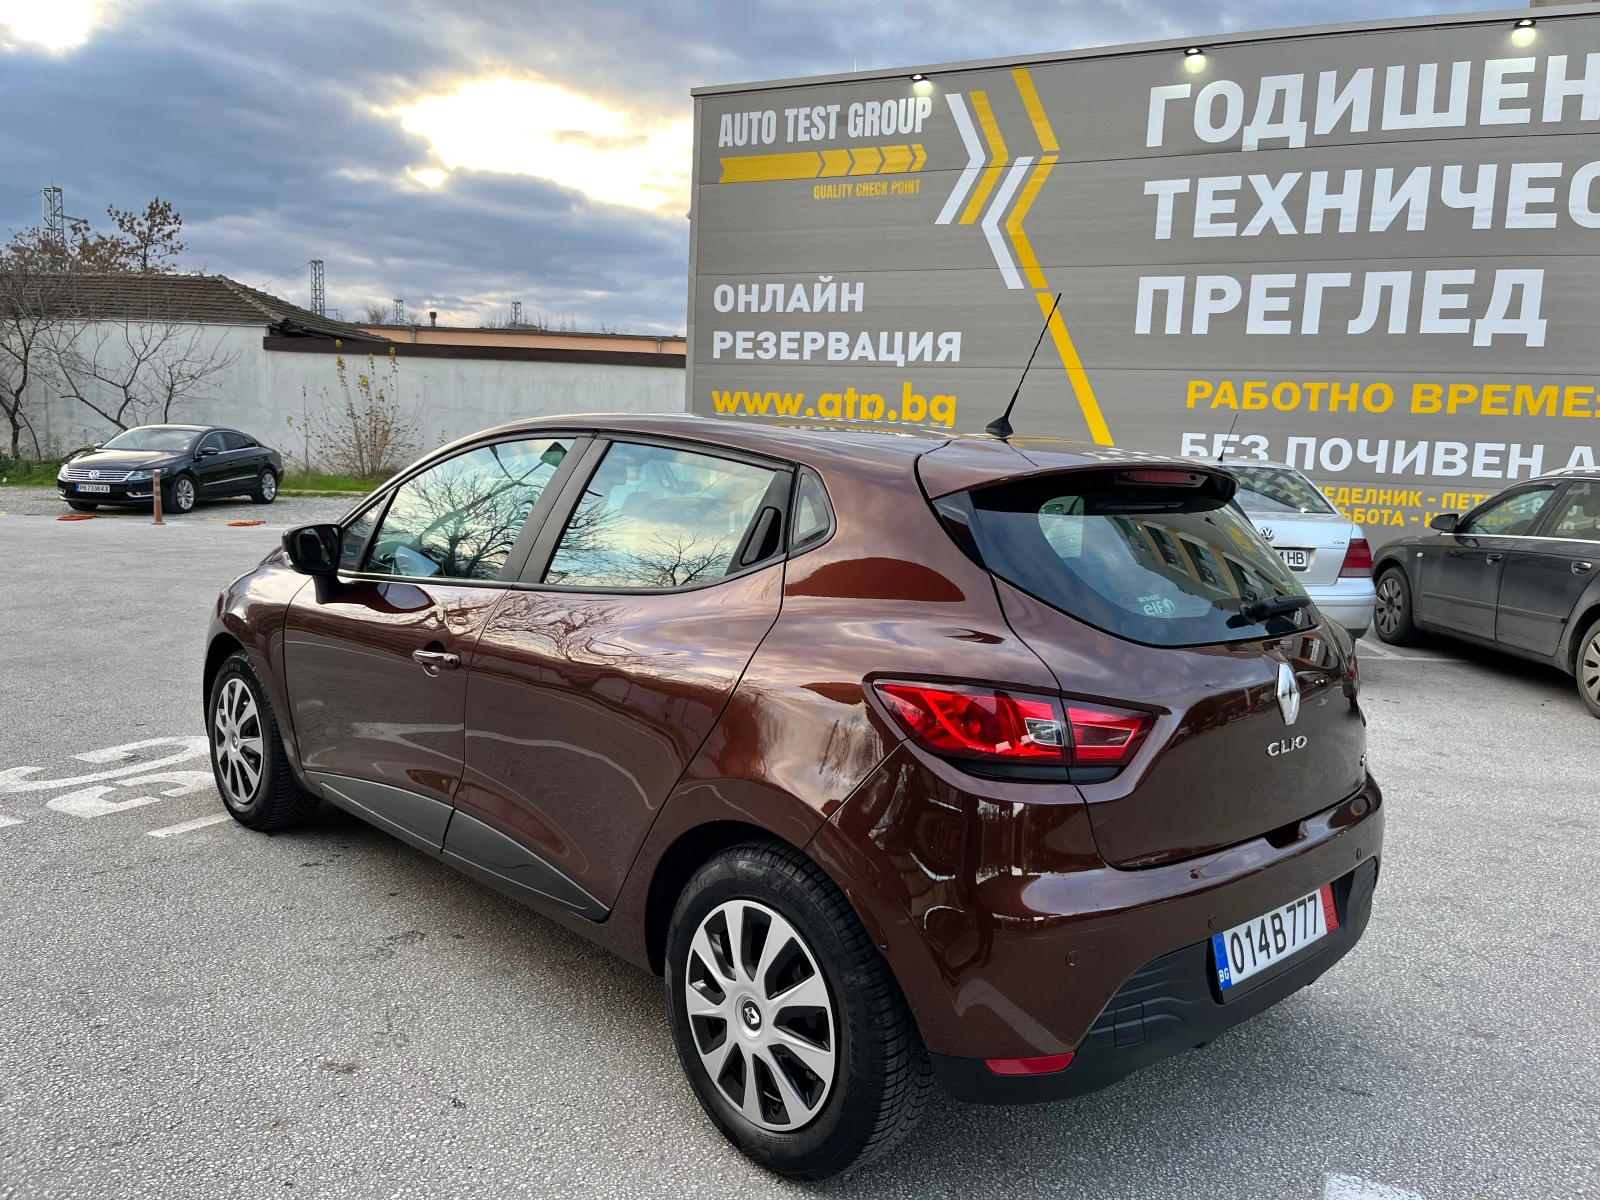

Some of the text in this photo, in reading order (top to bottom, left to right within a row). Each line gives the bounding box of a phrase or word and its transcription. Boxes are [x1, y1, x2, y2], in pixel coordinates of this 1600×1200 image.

[1146, 52, 1600, 152] ГОДИШЕН
[718, 96, 932, 148] AUTO TEST GROUP
[813, 179, 921, 200] QUALITY CHECK POINT
[713, 275, 865, 313] ОНЛАЙН
[1135, 268, 1547, 347] ПРЕГЛЕД
[712, 330, 962, 367] РЕЗЕРВАЦИЯ
[711, 382, 957, 427] www.atp.bg
[1186, 380, 1394, 414] РАБОТНО
[1180, 432, 1269, 461] БЕЗ
[1285, 436, 1544, 479] ПОЧИВЕН
[1318, 486, 1423, 508] ЕДЕЛНИК
[1143, 601, 1164, 616] elf
[1266, 735, 1308, 757] CLIO
[1230, 892, 1318, 975] 014B777
[1219, 967, 1230, 983] BG
